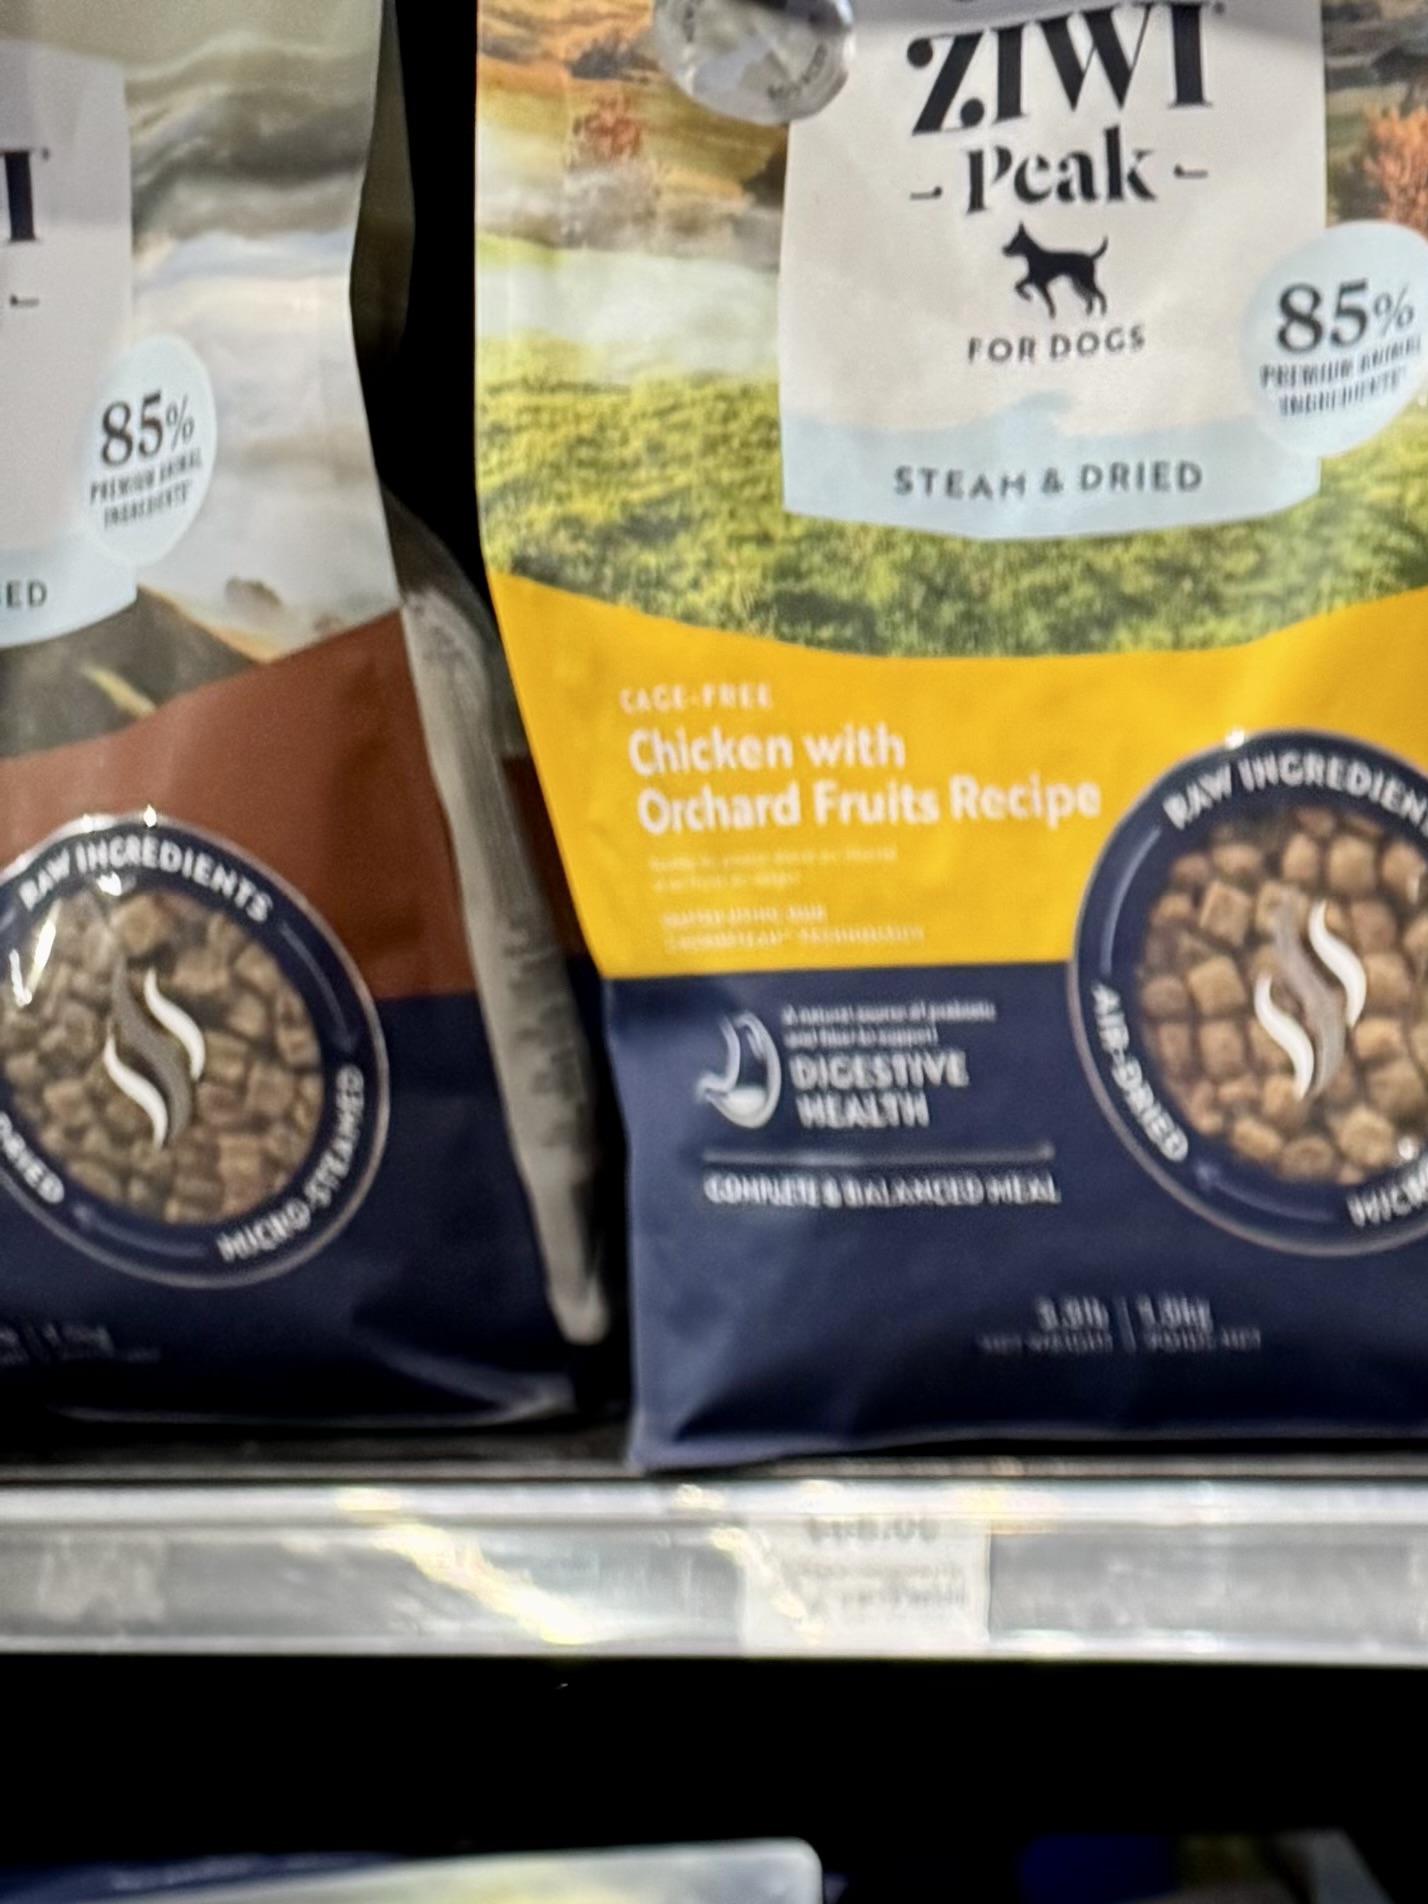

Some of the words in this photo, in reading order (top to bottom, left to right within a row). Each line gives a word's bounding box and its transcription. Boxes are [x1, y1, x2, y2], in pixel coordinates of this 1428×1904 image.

[907, 4, 1213, 136] ZIWI
[965, 126, 1160, 216] Peak
[967, 336, 1037, 365] FOR
[1049, 324, 1147, 359] DOGS
[1277, 277, 1414, 354] 85%
[102, 387, 196, 467] 85%
[893, 465, 1026, 502] STEAM
[1041, 467, 1066, 494] &
[1080, 459, 1203, 493] DRIED
[620, 683, 772, 714] CAGE-FREE
[629, 727, 793, 776] Chicken
[805, 722, 906, 769] with
[638, 781, 800, 835] Orchard
[815, 779, 940, 828] Fruits
[949, 773, 1101, 830] Recipe
[1163, 764, 1233, 831] RAW
[19, 853, 73, 910] RAW
[75, 834, 273, 923] INGREDIENTS
[789, 1049, 969, 1088] DIGESTIVE
[1091, 983, 1189, 1164] AIR-DRIED
[796, 1092, 929, 1128] HEALTH
